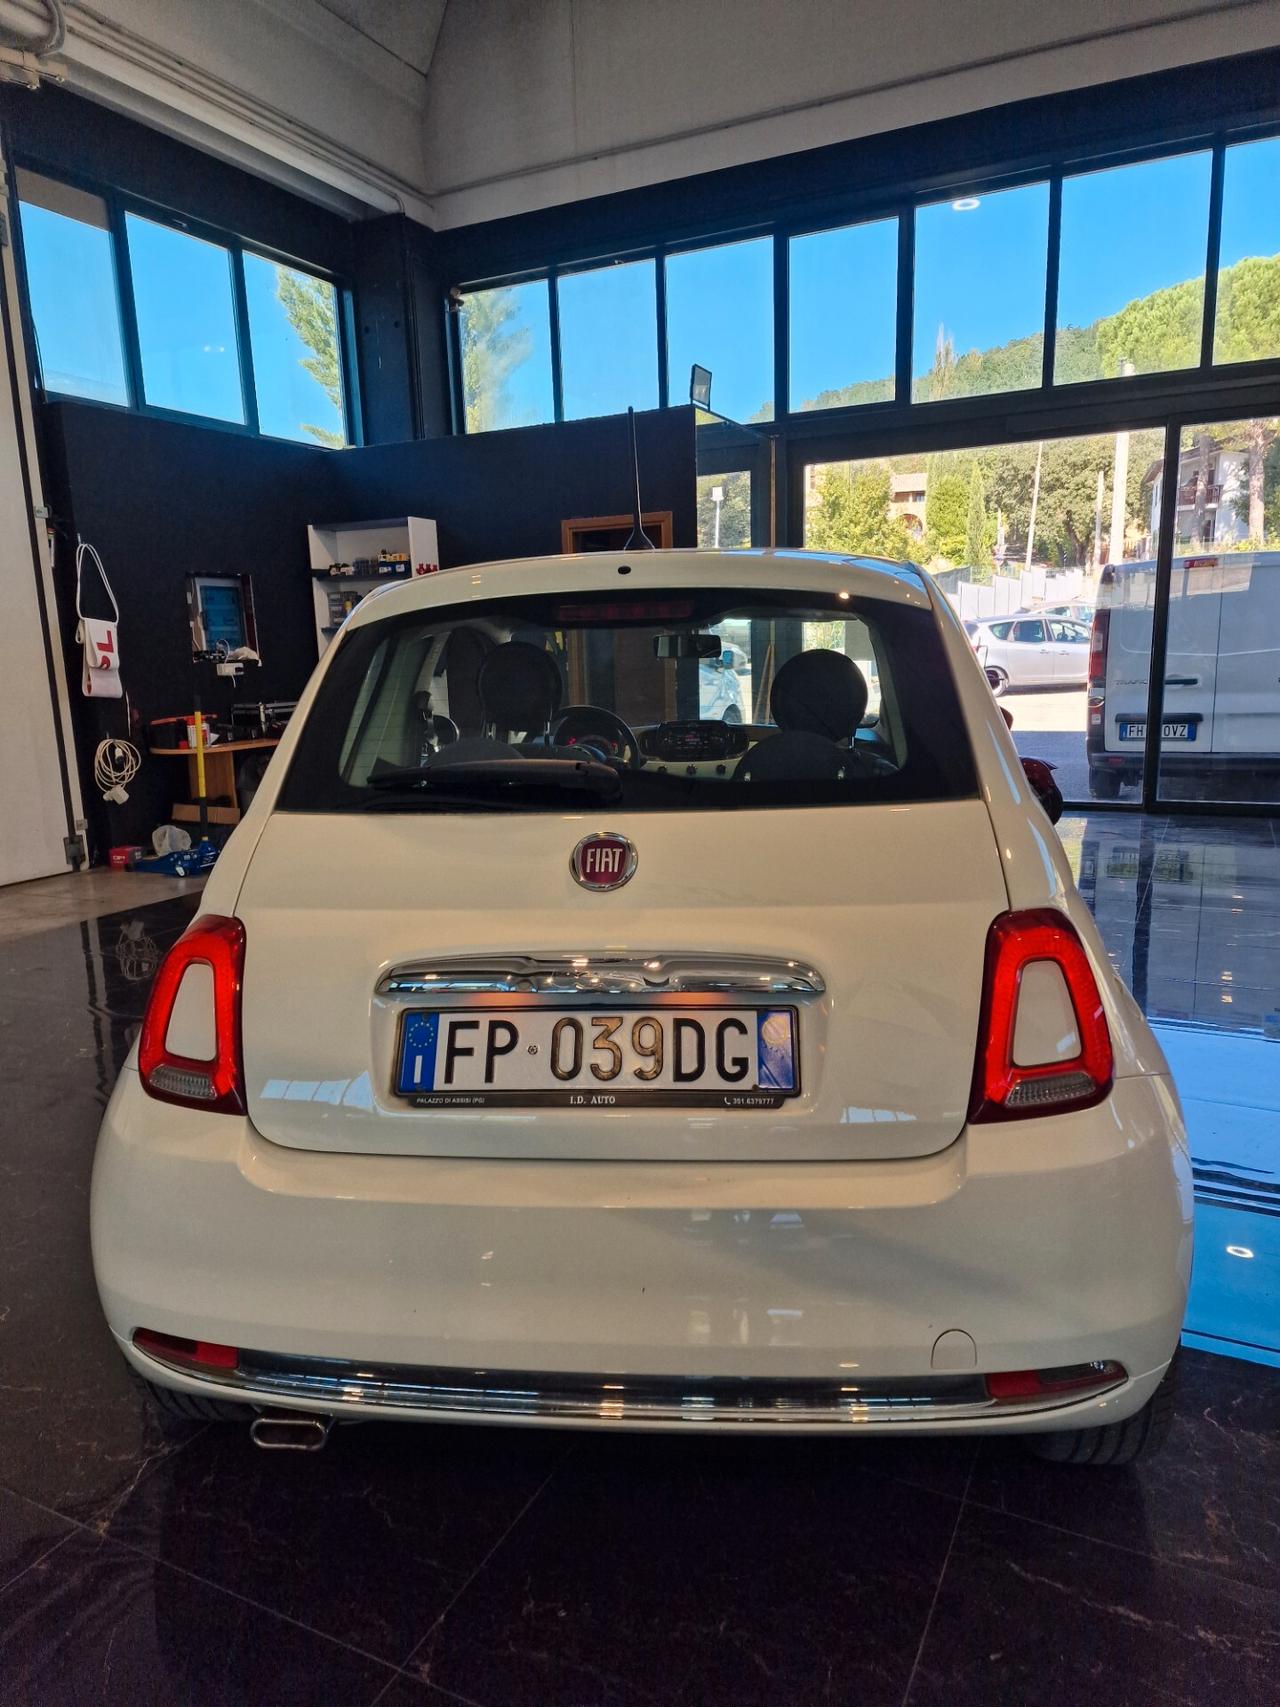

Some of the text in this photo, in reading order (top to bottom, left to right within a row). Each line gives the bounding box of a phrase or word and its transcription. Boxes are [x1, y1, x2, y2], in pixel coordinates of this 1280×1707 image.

[1128, 725, 1144, 737] FH
[585, 847, 623, 873] FIAT
[416, 1096, 444, 1104] PALAZZO
[451, 1096, 472, 1104] ASSISI
[590, 1095, 616, 1105] AUTO
